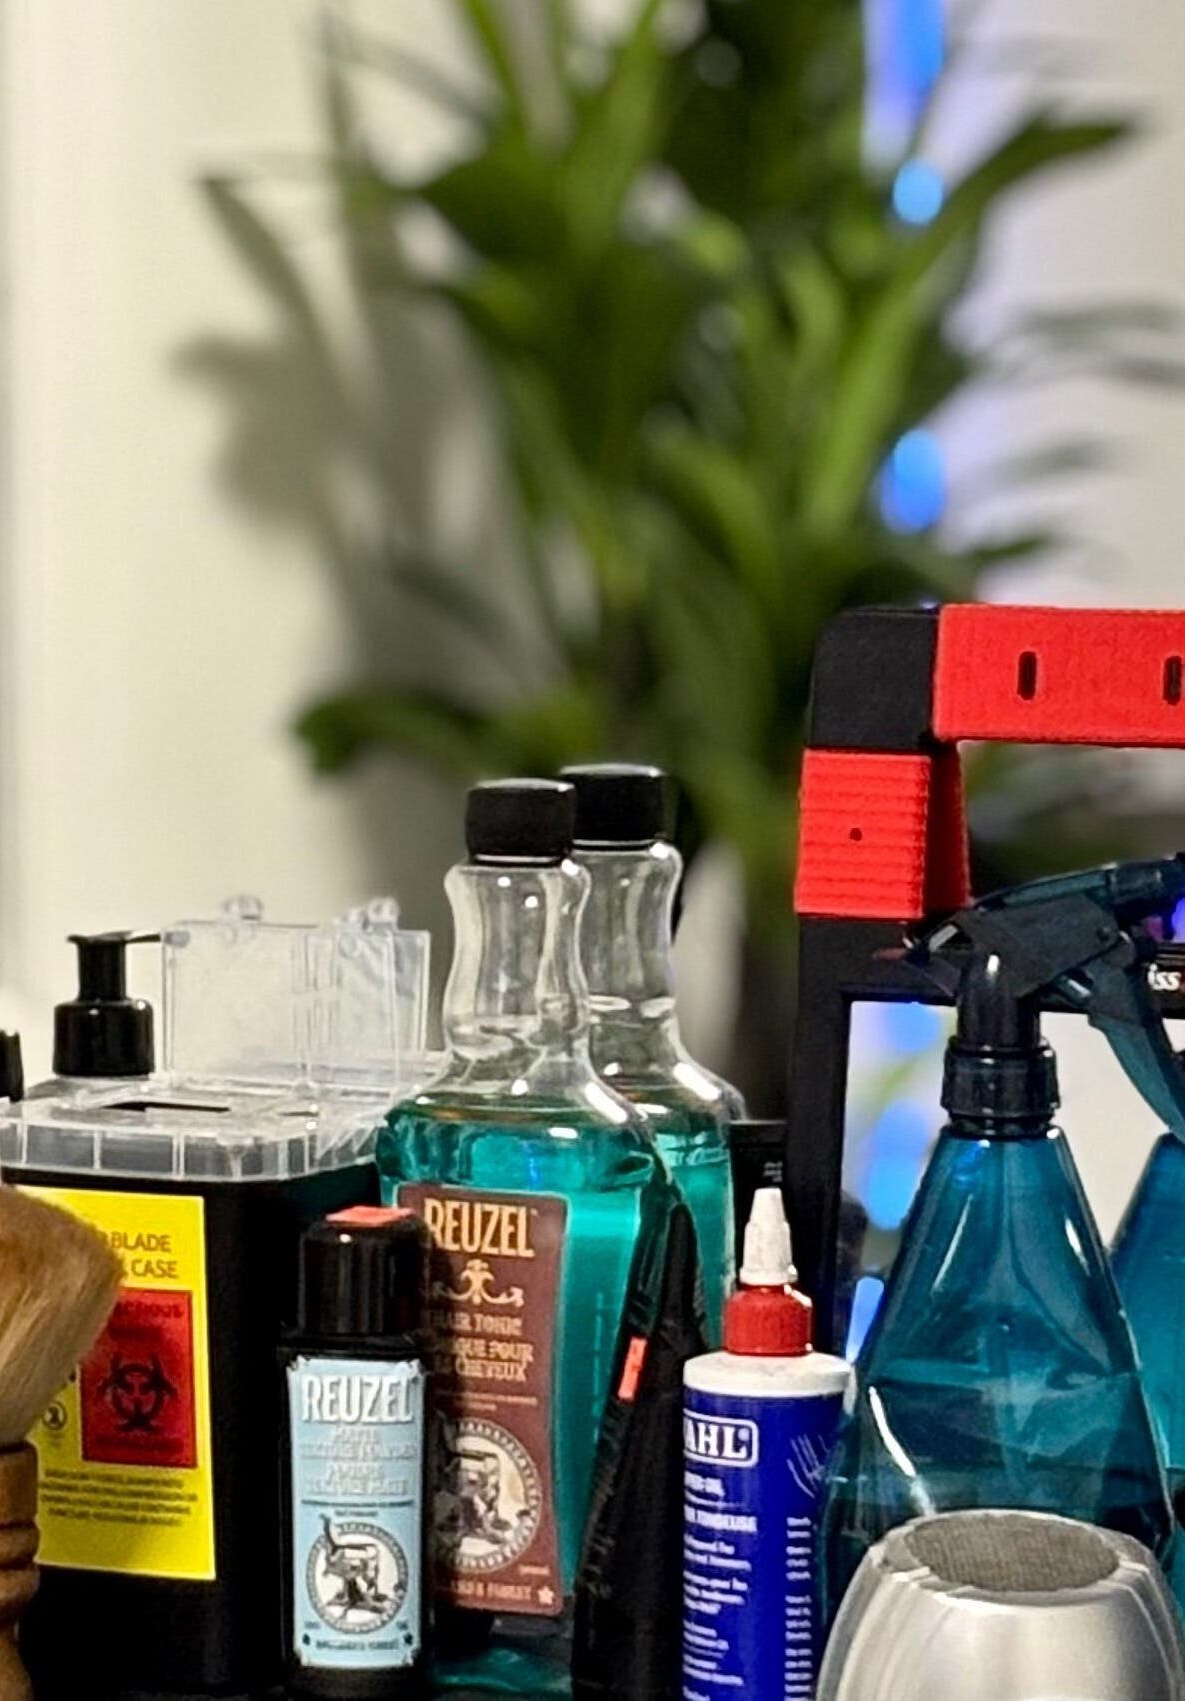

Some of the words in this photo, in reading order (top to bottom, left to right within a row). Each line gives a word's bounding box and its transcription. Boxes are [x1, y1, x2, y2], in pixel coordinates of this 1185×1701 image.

[111, 1231, 171, 1253] BLADE
[424, 1198, 535, 1258] REUZEL
[130, 1258, 178, 1279] CASE
[301, 1375, 413, 1424] REUZEL
[683, 1417, 748, 1460] AHL
